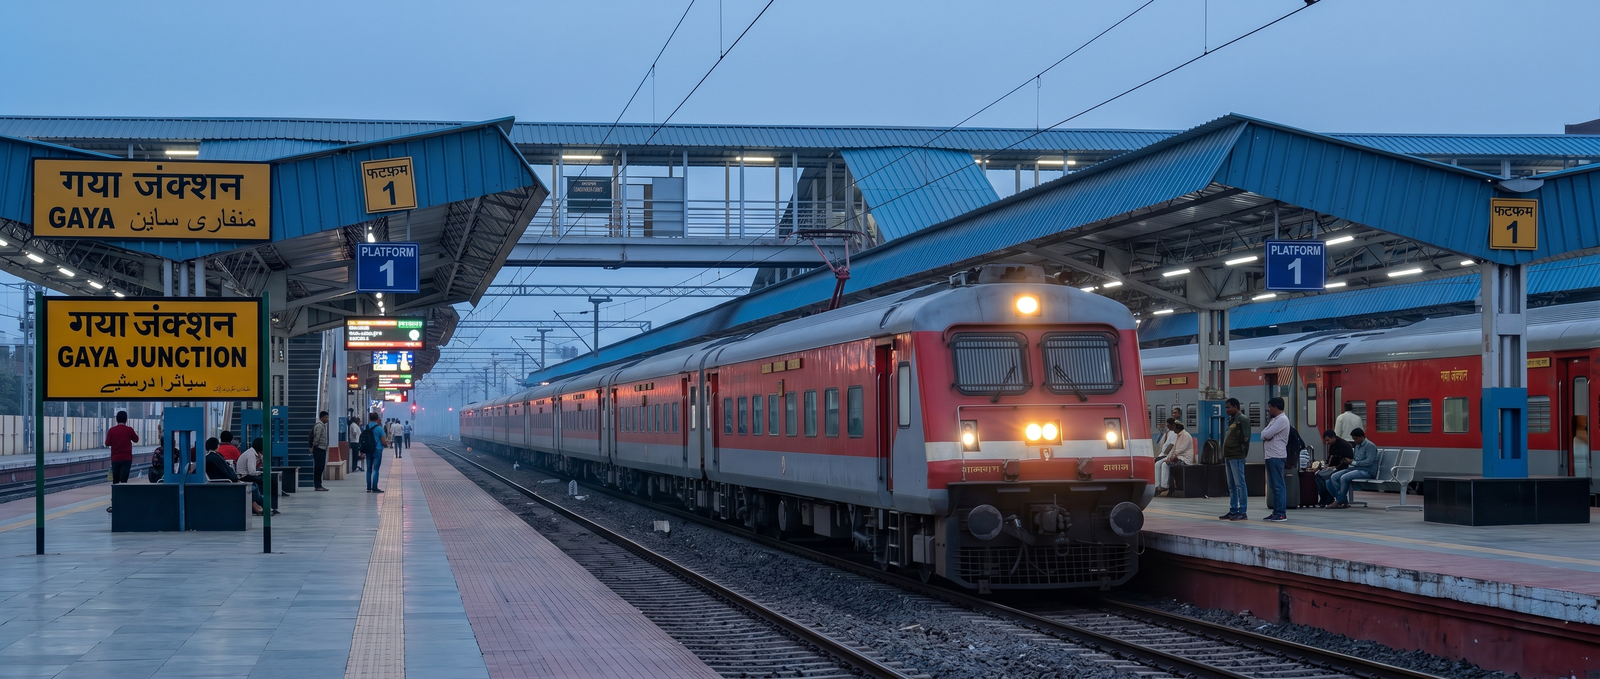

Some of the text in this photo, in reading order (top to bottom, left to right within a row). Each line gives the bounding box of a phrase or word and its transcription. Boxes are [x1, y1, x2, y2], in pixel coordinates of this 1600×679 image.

[60, 165, 244, 200] गया जंक्शन
[382, 181, 396, 205] 1
[49, 207, 115, 229] GAYA
[1506, 220, 1518, 243] 1
[361, 247, 414, 257] PLATFORM
[1271, 245, 1321, 256] PLATFORM
[379, 259, 394, 286] 1
[1287, 257, 1302, 285] 1
[68, 304, 237, 341] गया जंक्शन
[58, 346, 247, 368] GAYA JUNCTION
